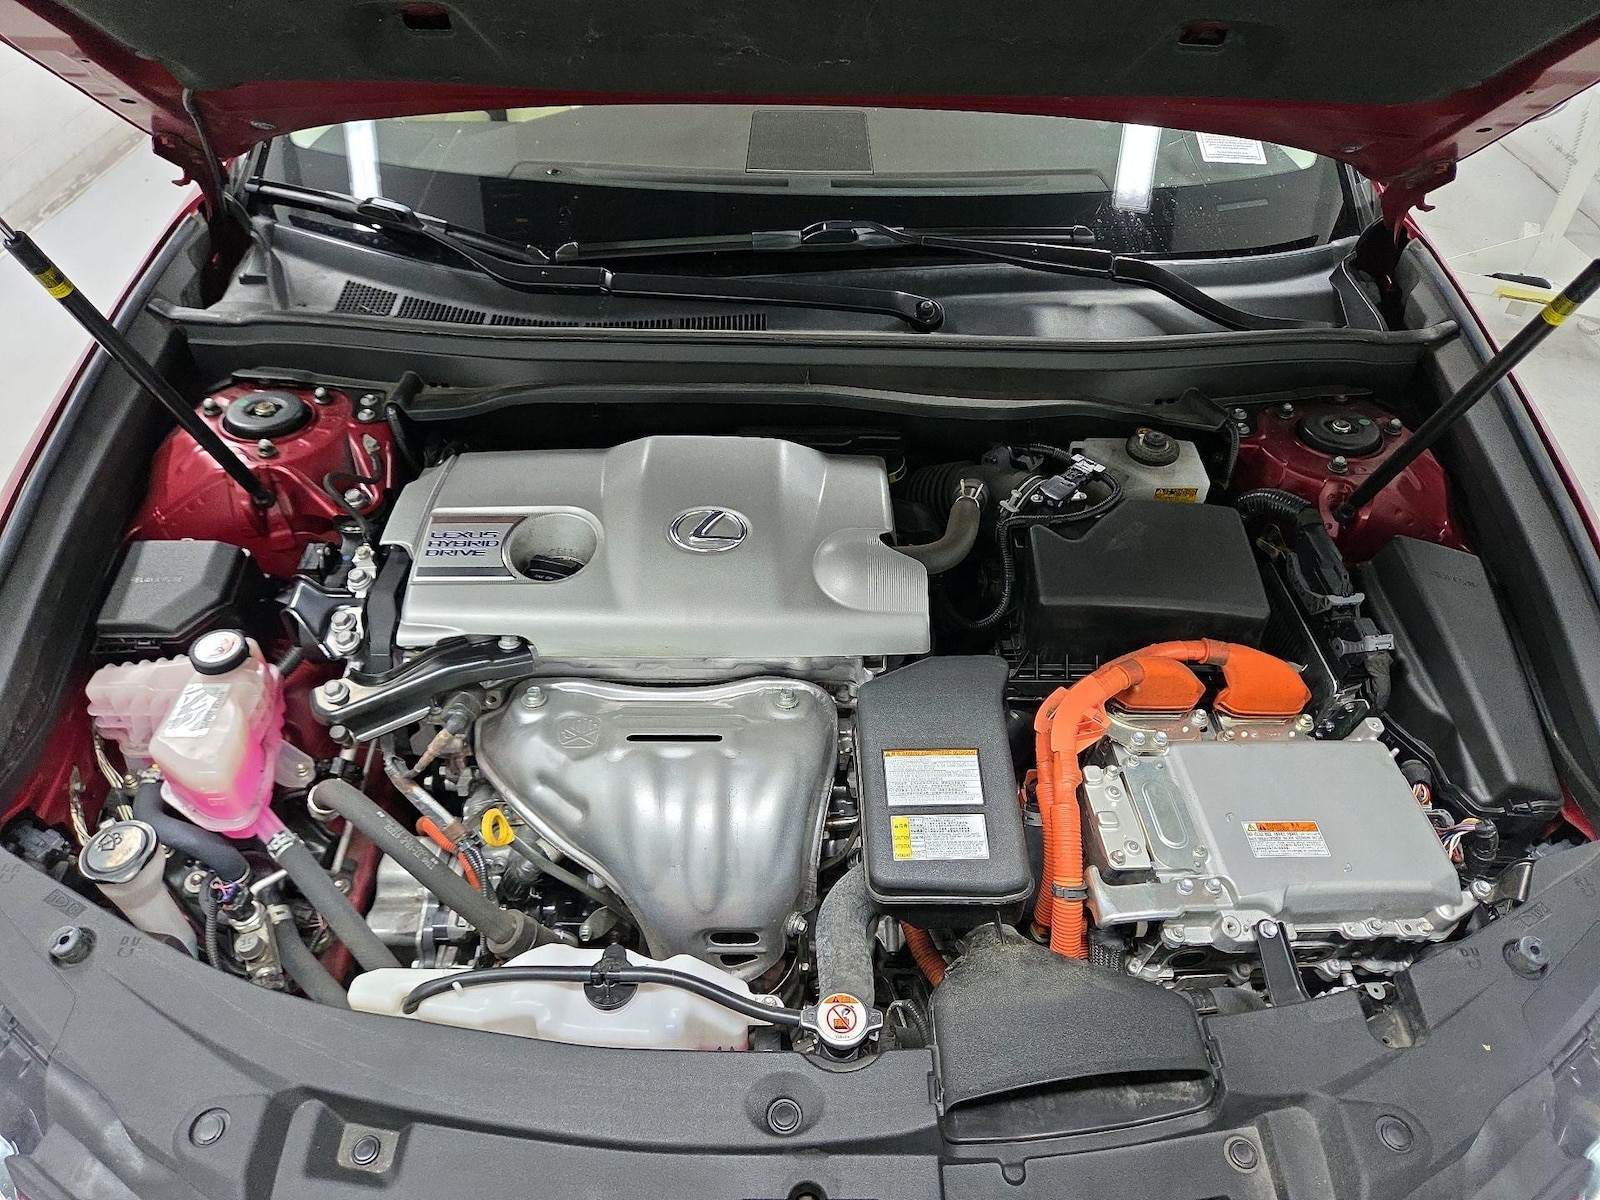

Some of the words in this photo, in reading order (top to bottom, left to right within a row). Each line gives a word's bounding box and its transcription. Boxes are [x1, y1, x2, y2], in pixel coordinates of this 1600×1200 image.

[431, 531, 499, 539] LEXUS
[428, 540, 500, 548] HYBRID
[425, 549, 486, 557] DRIVE
